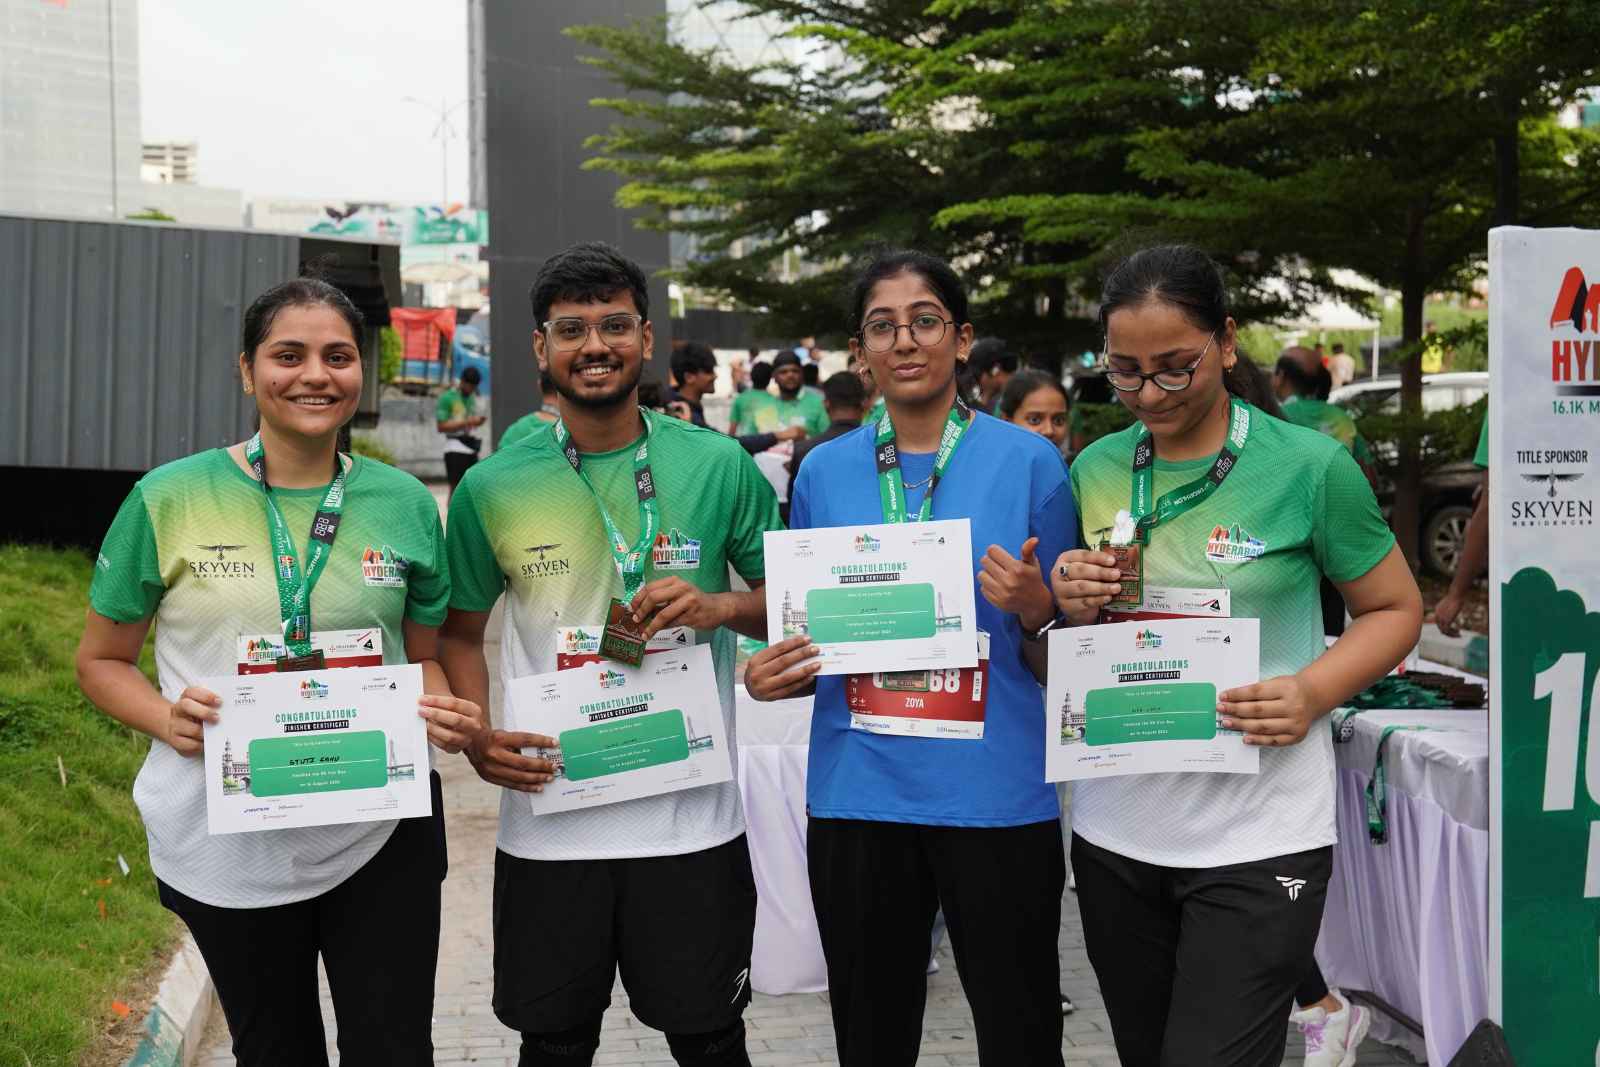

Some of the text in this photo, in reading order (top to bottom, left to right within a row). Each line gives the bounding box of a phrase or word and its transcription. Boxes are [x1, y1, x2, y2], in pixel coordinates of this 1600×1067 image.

[1552, 400, 1584, 414] 16.1K
[1517, 450, 1588, 464] TITLE SPONSOR
[1511, 500, 1592, 519] SKYVEN
[189, 561, 255, 574] SKYVEN
[521, 559, 569, 576] SKYVEN
[830, 561, 908, 575] CONGRATULATIONS
[1111, 659, 1189, 674] CONGRATULATIONS
[1118, 670, 1181, 682] FINISHER CERTIFICATE
[579, 692, 655, 715] CONGRATULATIONS
[904, 697, 925, 709] ZOYA
[275, 708, 358, 723] CONGRATULATIONS
[284, 721, 349, 732] FINISHER CERTIFICATE
